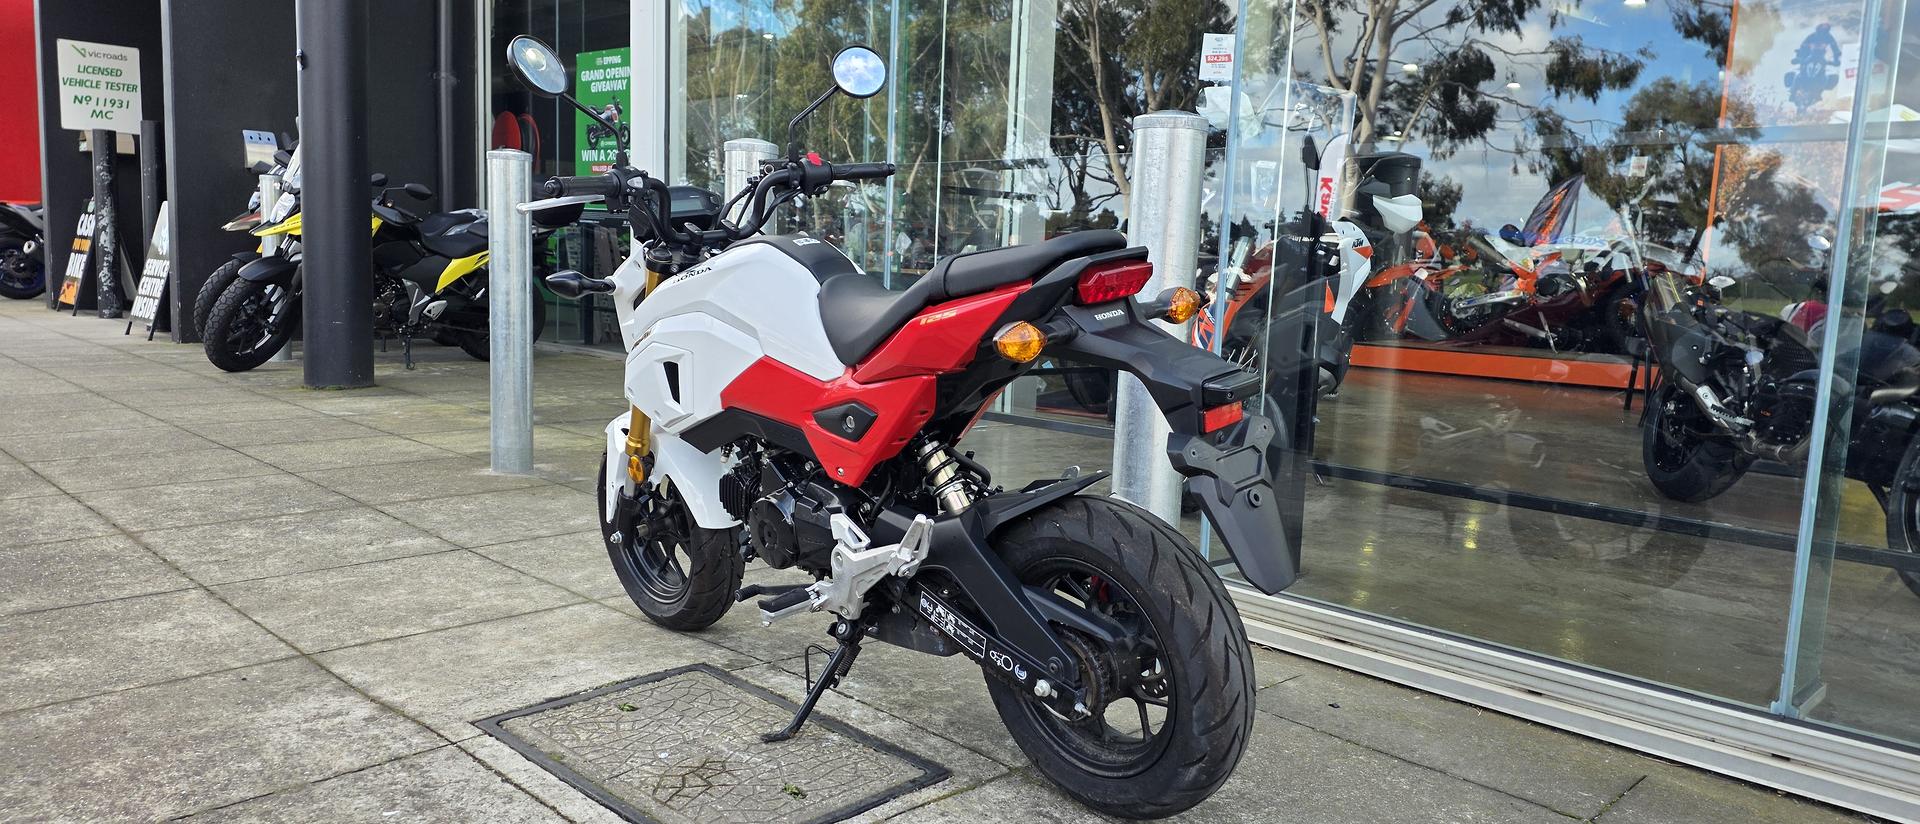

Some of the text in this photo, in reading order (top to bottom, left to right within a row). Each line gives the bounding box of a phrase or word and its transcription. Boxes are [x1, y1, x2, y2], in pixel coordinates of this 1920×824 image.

[77, 64, 123, 78] LICENSED
[581, 66, 630, 81] GRAND OPENIN
[62, 77, 138, 93] VEHICLE TESTER
[590, 79, 628, 92] GIVEAWAY
[95, 97, 130, 109] 11931
[90, 109, 114, 120] MC
[581, 149, 598, 161] WIN
[599, 149, 606, 161] A
[66, 252, 87, 278] BIKE
[143, 258, 170, 278] SERVICE
[138, 276, 164, 298] CENTRE
[131, 295, 158, 320] INSIDE
[1094, 309, 1125, 321] HONDA
[919, 310, 957, 325] 125
